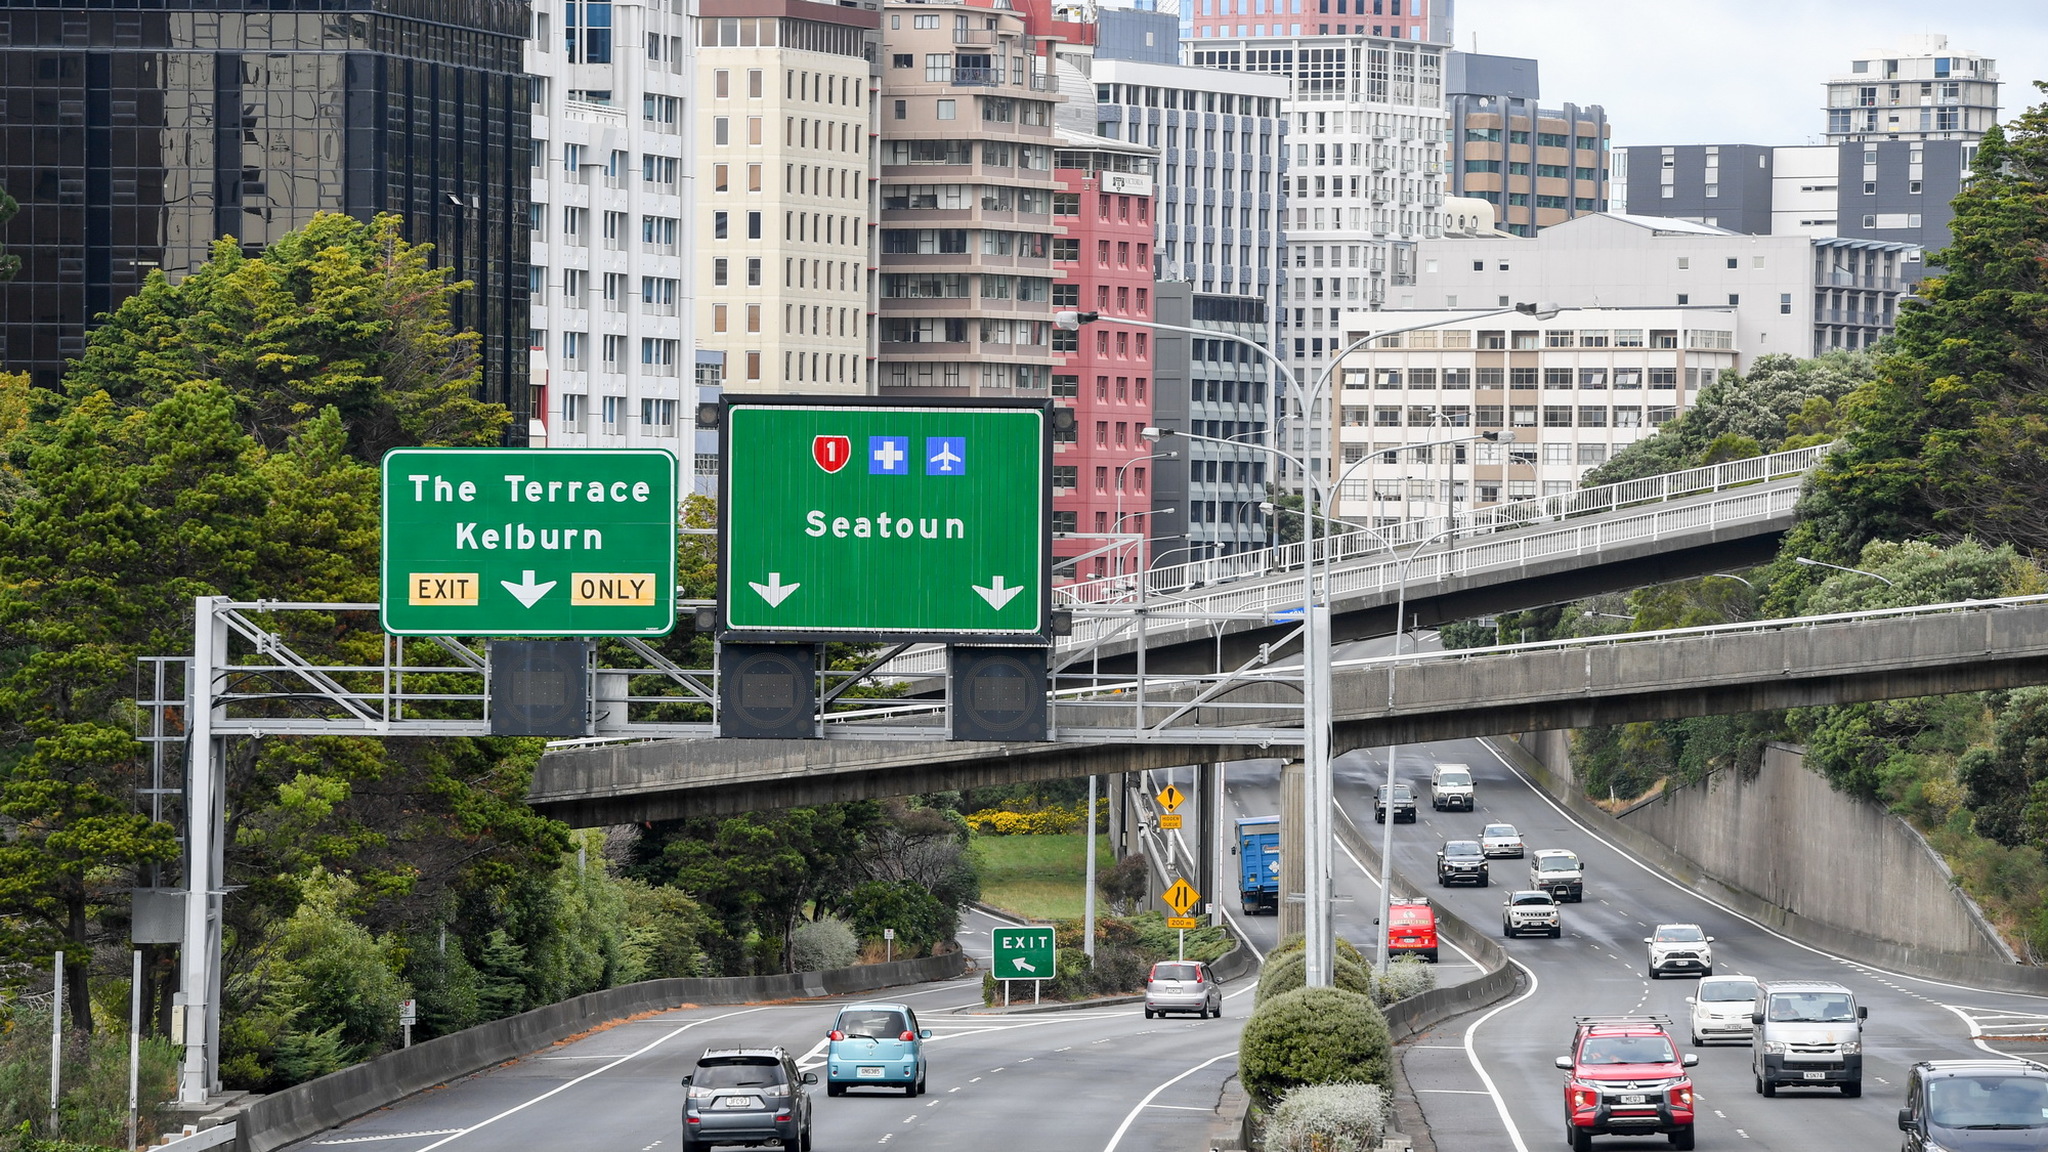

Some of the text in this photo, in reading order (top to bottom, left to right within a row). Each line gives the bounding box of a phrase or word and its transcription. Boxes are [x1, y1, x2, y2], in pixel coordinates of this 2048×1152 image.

[826, 441, 836, 462] 1
[408, 474, 650, 502] The Terrace
[456, 522, 602, 550] Kelburn
[804, 510, 964, 539] Seatoun
[418, 579, 646, 600] EXIT ONLY
[1002, 936, 1048, 949] EXIT
